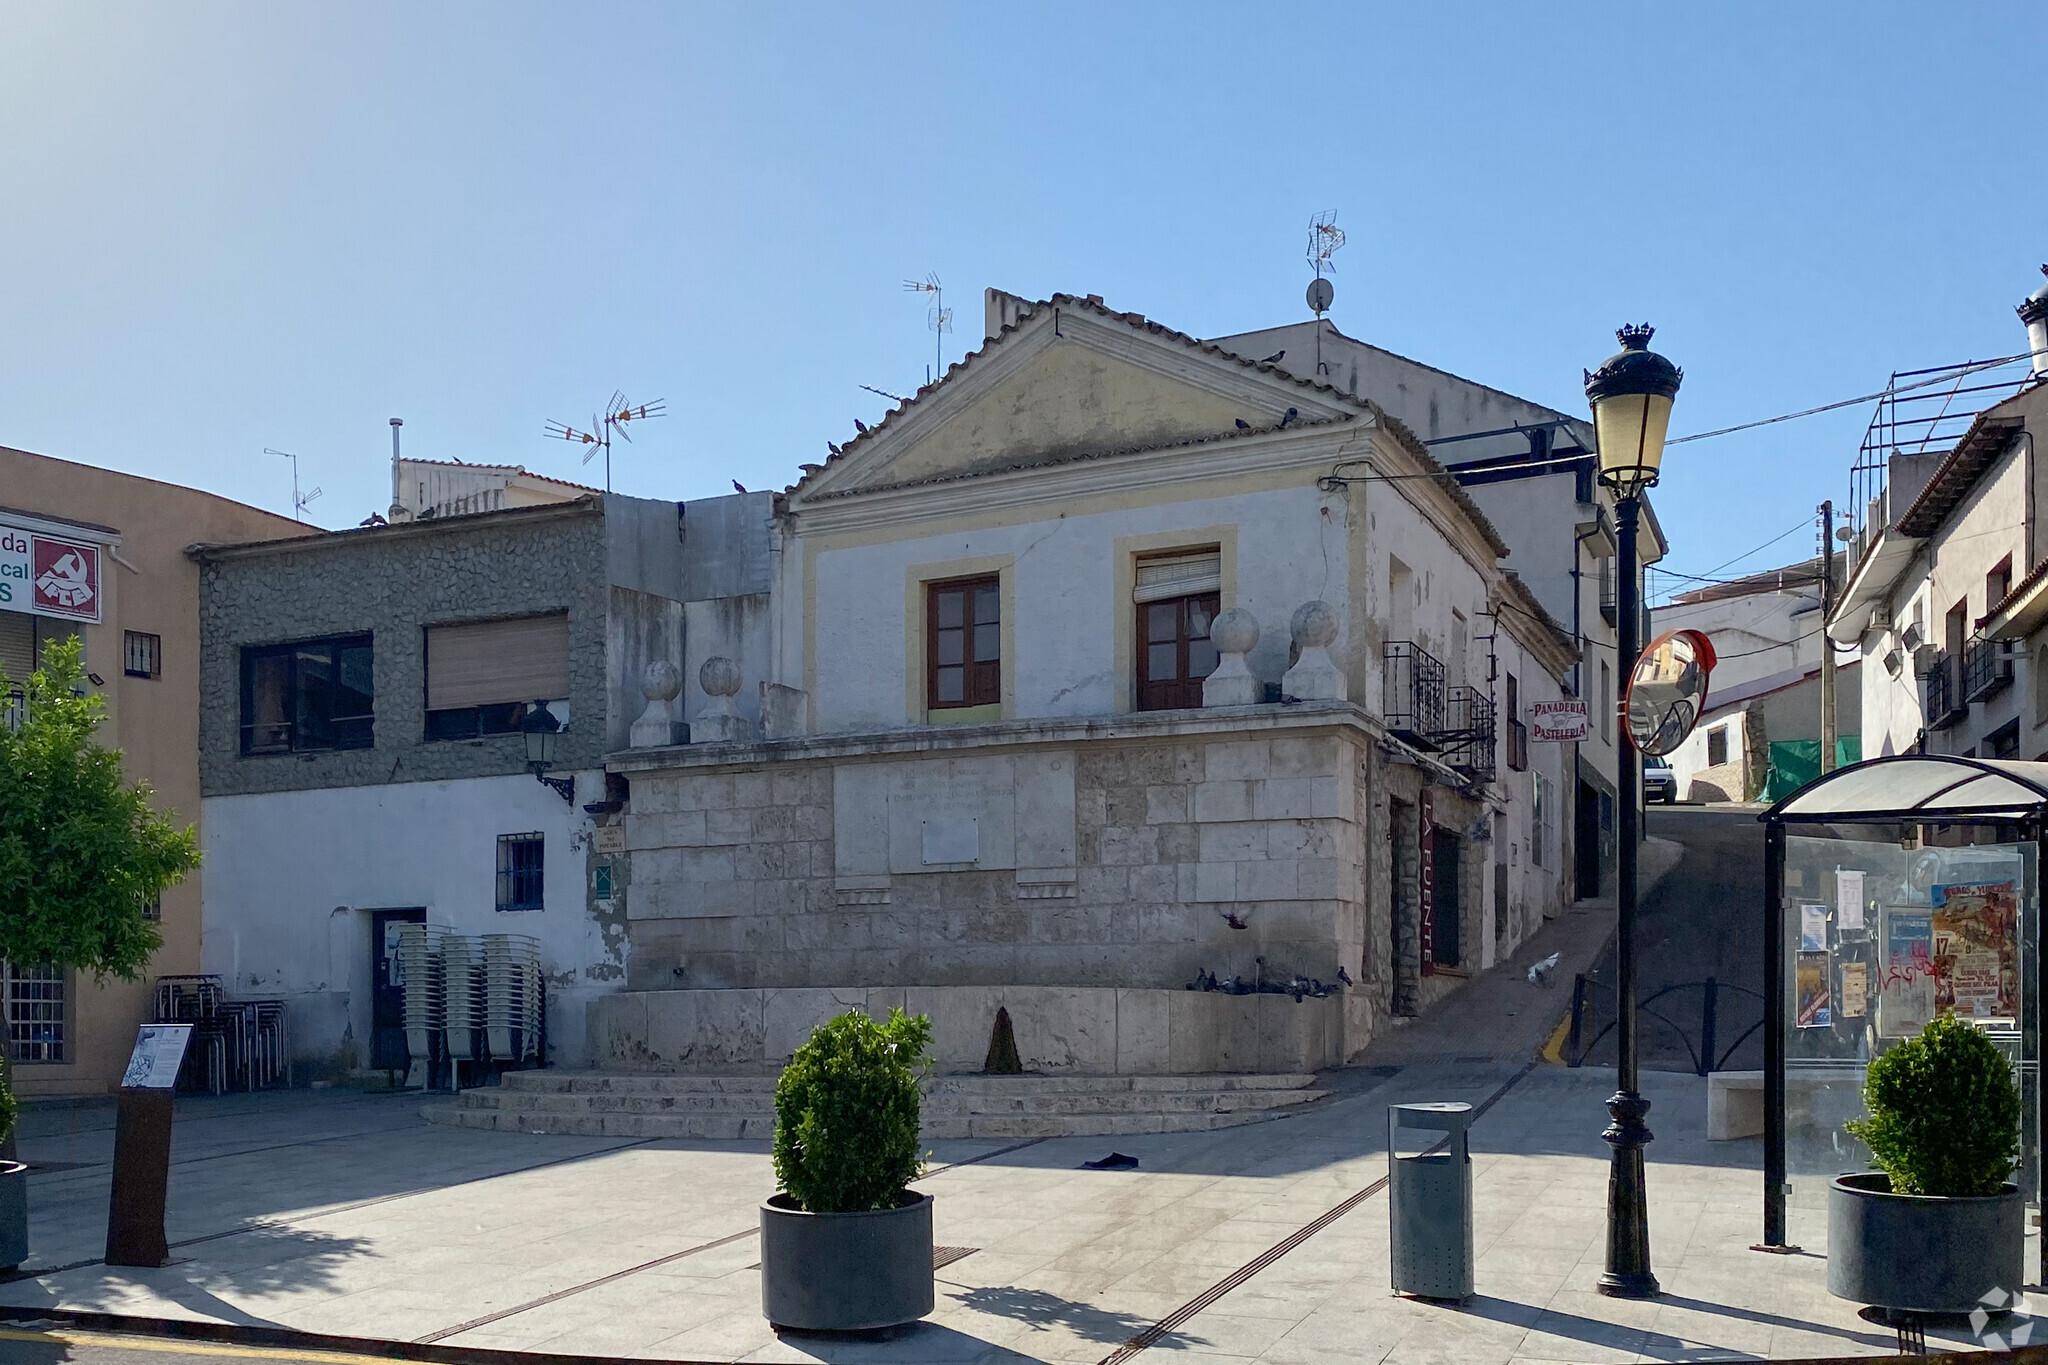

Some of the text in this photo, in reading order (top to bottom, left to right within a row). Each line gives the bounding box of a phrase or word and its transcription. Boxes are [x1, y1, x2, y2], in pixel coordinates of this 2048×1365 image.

[1534, 702, 1587, 717] PANADERIA
[1534, 723, 1586, 739] PASTELERIA
[1423, 803, 1432, 963] LA FUENTE
[1936, 938, 1949, 955] 17
